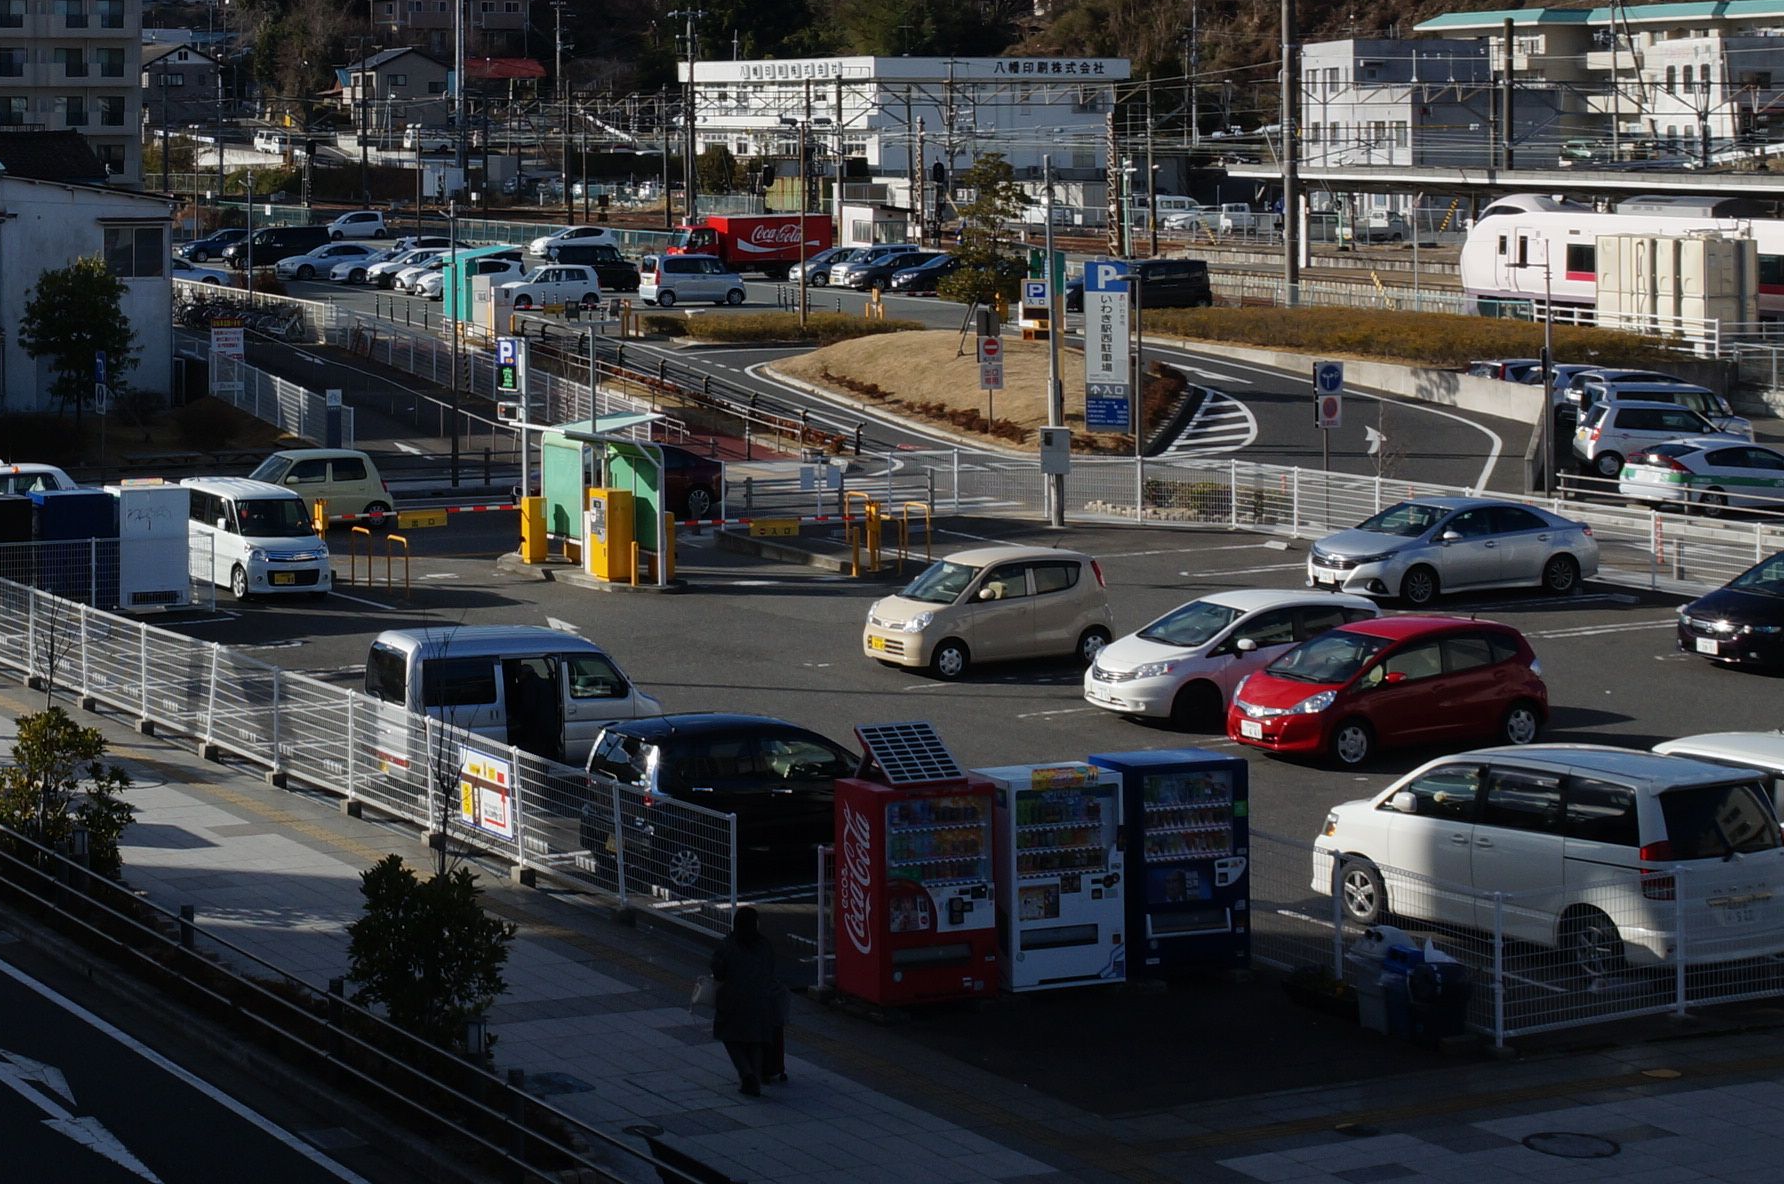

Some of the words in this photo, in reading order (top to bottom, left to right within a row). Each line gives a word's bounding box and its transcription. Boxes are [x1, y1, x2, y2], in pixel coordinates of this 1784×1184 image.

[993, 61, 1105, 75] 八幡印刷株式会社
[751, 224, 801, 244] Coca-Cola
[1098, 265, 1117, 289] P
[1029, 284, 1043, 296] P
[1100, 295, 1112, 372] いわき駅西駐車場
[499, 341, 513, 364] P
[1103, 385, 1124, 394] 入口
[412, 518, 435, 527] 出口
[843, 800, 872, 955] Coca-Cola
